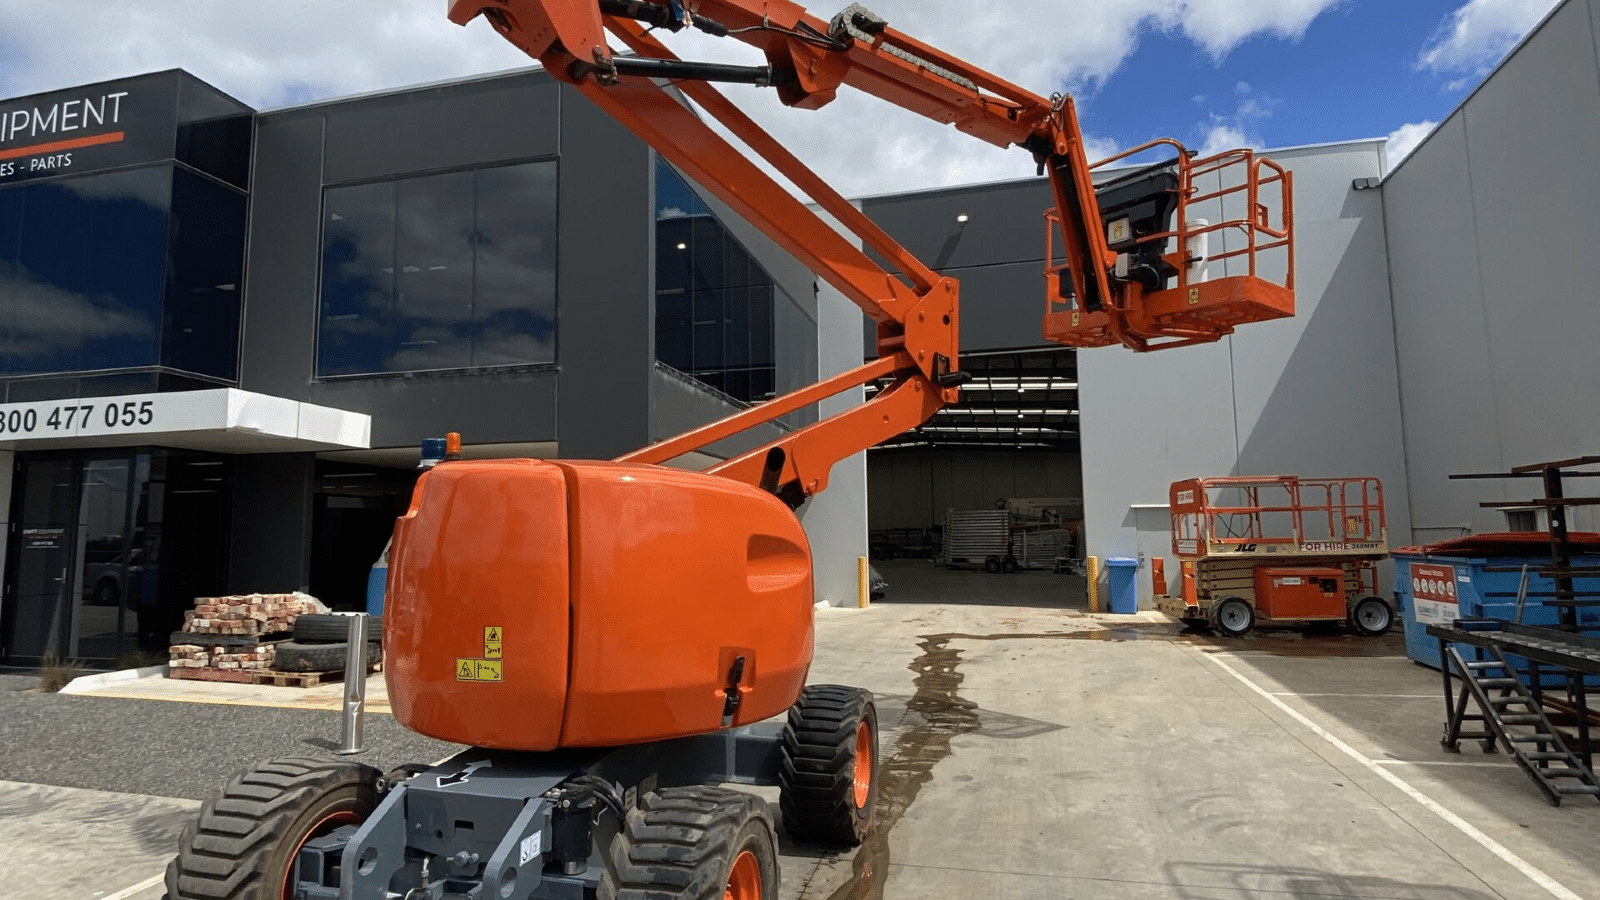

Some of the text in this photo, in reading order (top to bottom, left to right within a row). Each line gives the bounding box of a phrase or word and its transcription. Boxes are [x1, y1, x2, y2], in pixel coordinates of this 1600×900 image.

[0, 91, 128, 142] IPMENT
[30, 153, 72, 172] PARTS
[47, 404, 94, 430] 477
[105, 401, 153, 427] 055
[1300, 542, 1350, 551] FOR HIRE
